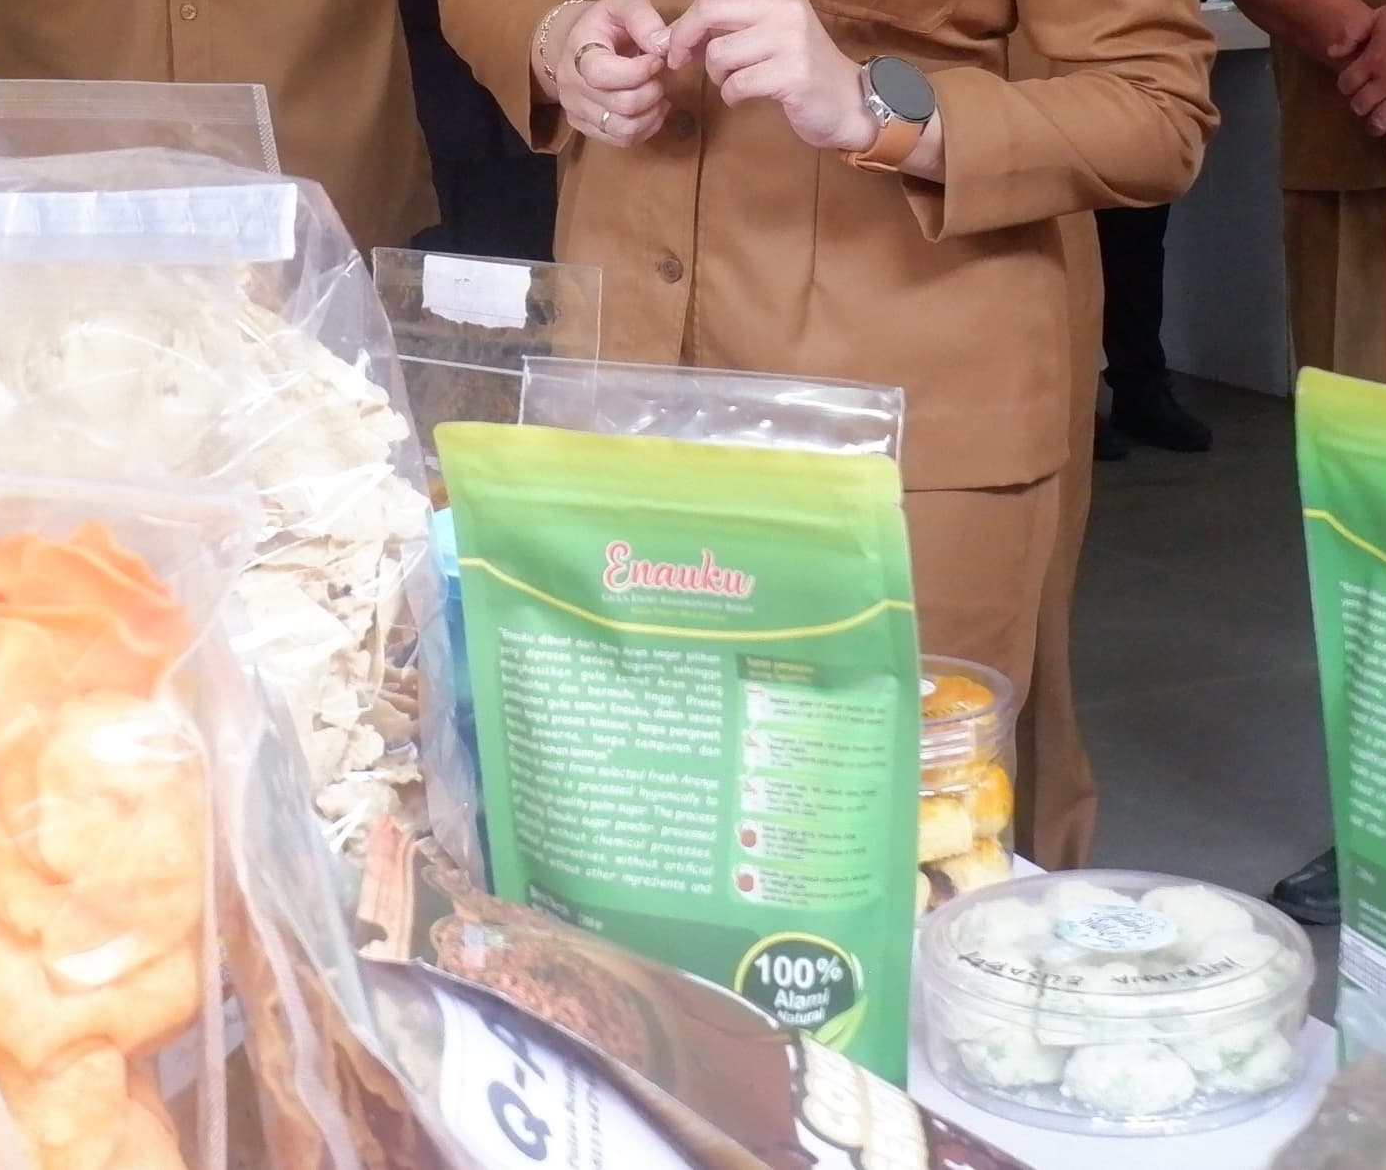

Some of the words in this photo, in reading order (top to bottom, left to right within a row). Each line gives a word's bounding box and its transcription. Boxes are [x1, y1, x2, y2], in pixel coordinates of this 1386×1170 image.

[603, 541, 755, 599] Enauku
[754, 953, 844, 989] 100%
[774, 988, 830, 1011] Alami
[777, 1007, 826, 1024] Natural
